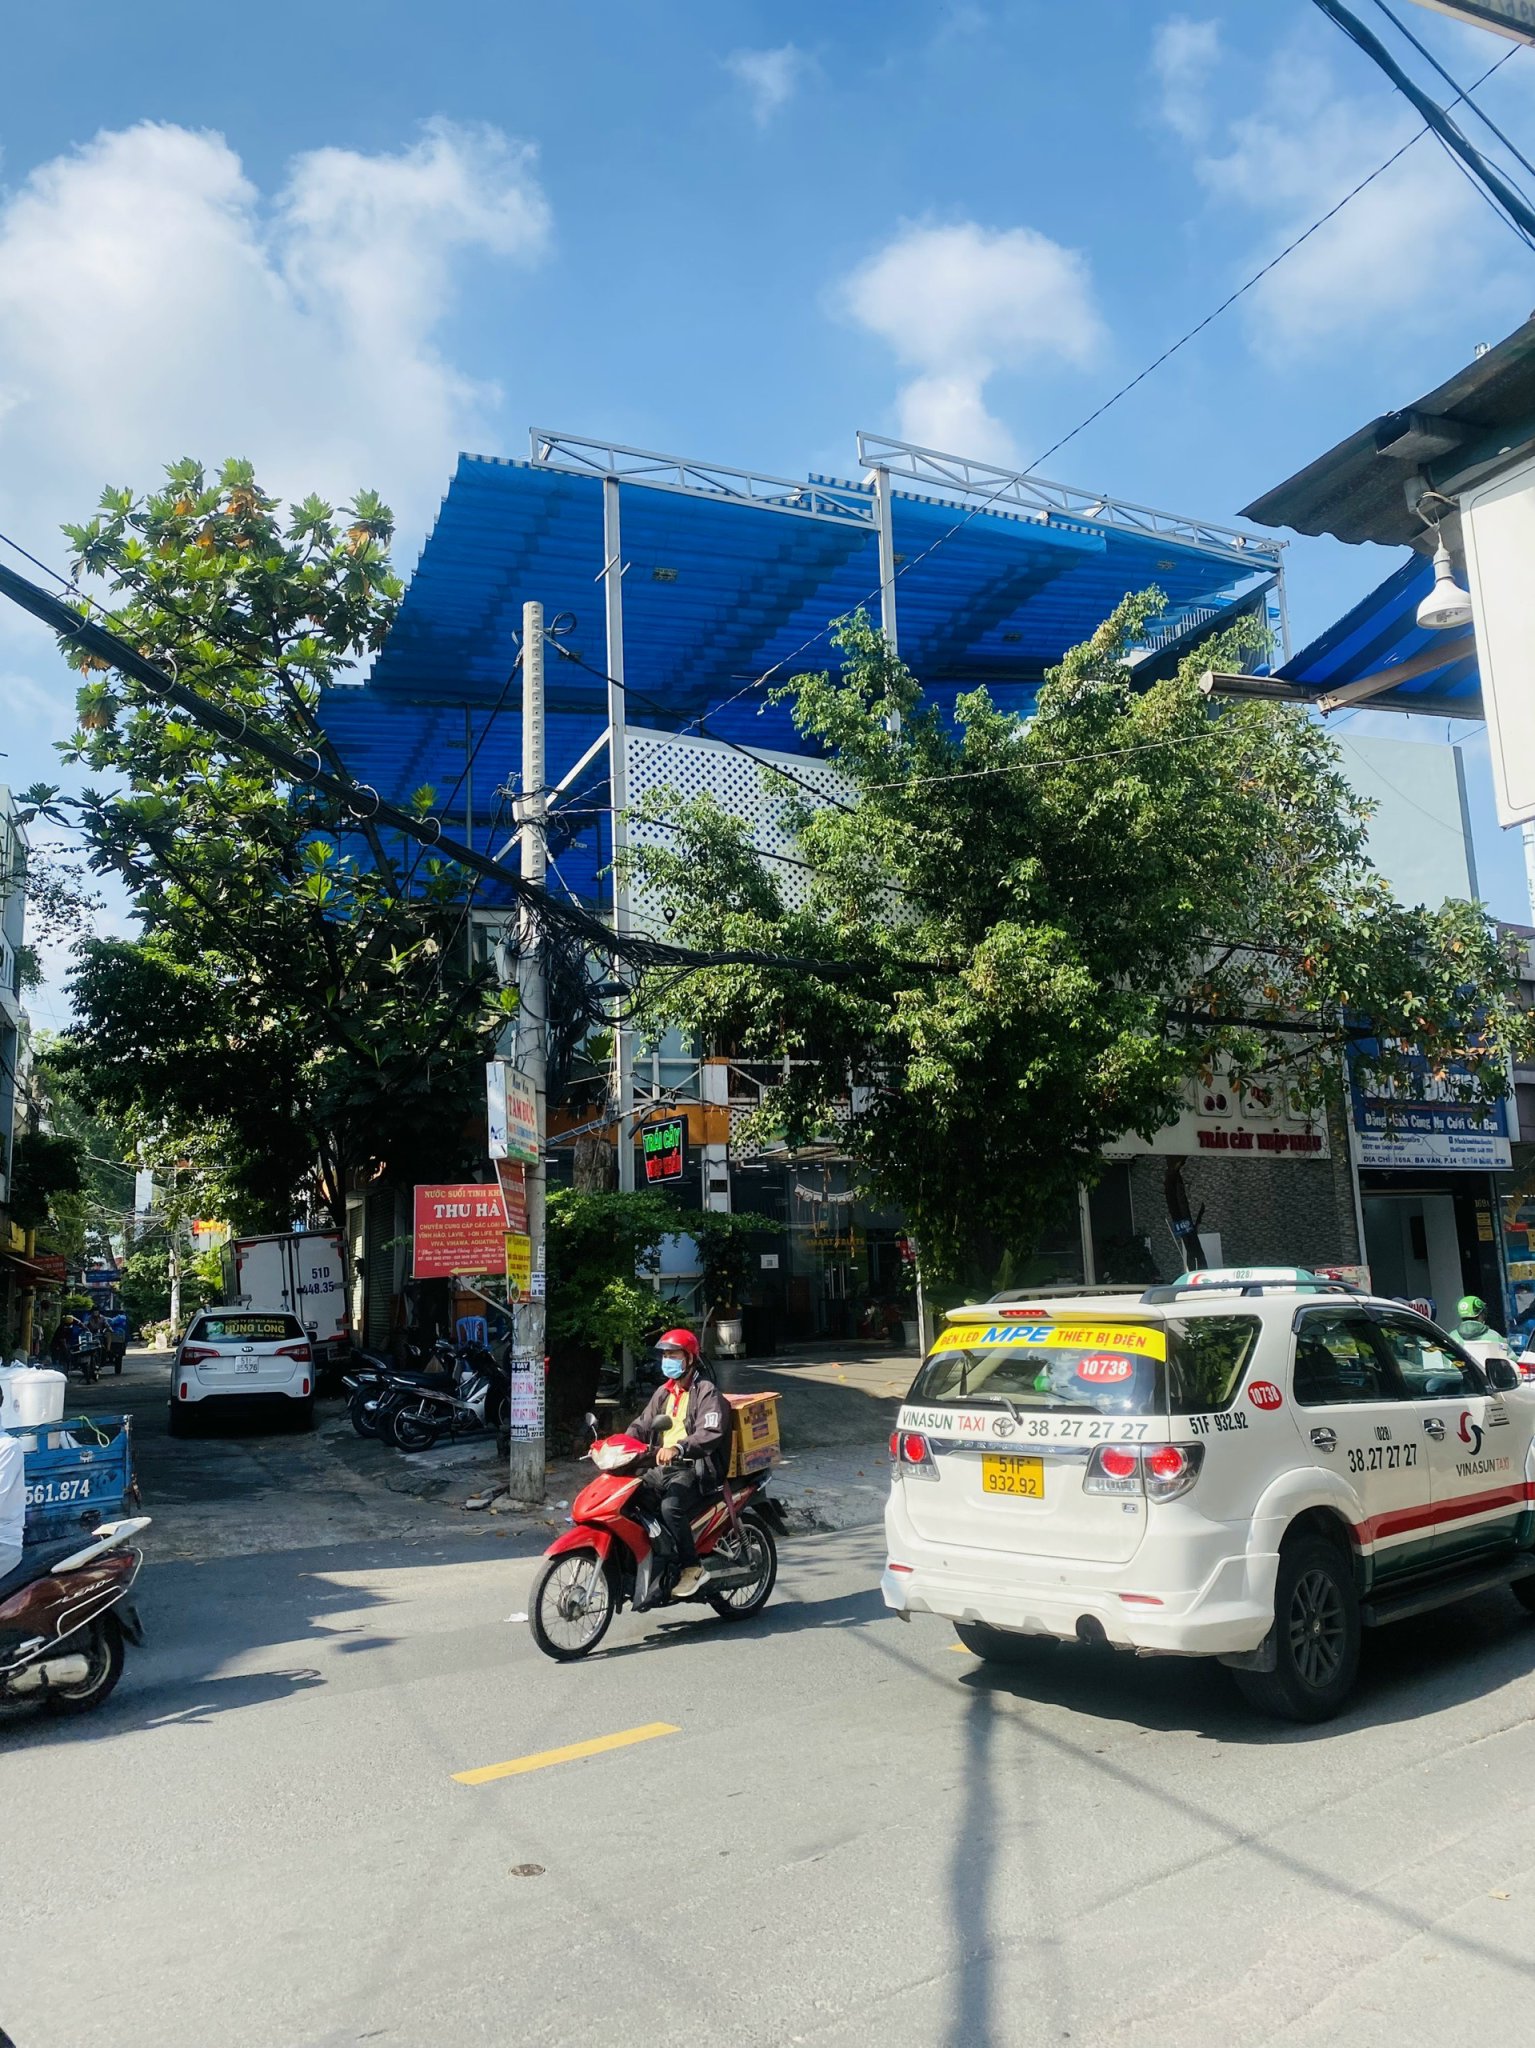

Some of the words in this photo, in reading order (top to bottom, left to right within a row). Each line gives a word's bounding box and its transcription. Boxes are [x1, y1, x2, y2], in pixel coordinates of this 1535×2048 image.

[1411, 1115, 1431, 1130] Cùng
[1433, 1114, 1444, 1132] Nụ
[1483, 1118, 1498, 1134] Bạn
[643, 1127, 663, 1152] TRÁI
[663, 1124, 681, 1148] CÂY
[1197, 1126, 1229, 1148] TRÁI
[1230, 1127, 1254, 1149] CÂY
[448, 1187, 466, 1198] SUỐI
[433, 1204, 471, 1218] THU
[475, 1199, 501, 1217] HÀ
[311, 1266, 330, 1279] 51D
[1233, 1269, 1253, 1279] (028)
[302, 1281, 335, 1295] 448.35
[225, 1322, 255, 1333] HÙNG
[257, 1324, 285, 1333] LONG
[959, 1331, 979, 1343] LED
[981, 1326, 1056, 1342] MPE
[1057, 1328, 1093, 1342] THIẾT
[1095, 1332, 1111, 1346] BỊ
[1112, 1331, 1147, 1348] ĐIỆN
[1083, 1360, 1127, 1375] 10738
[1249, 1385, 1279, 1404] 10738
[902, 1411, 953, 1429] VINASUN
[957, 1415, 985, 1432] TAXI
[1088, 1421, 1114, 1439] 27
[1121, 1423, 1149, 1440] 27
[1189, 1416, 1210, 1434] 51F
[1214, 1412, 1248, 1431] 932.92
[1374, 1426, 1392, 1440] (028)
[1000, 1457, 1025, 1474] 51F
[1348, 1447, 1382, 1473] 38.27
[1386, 1445, 1400, 1468] 27
[1403, 1443, 1417, 1466] 27
[25, 1479, 90, 1505] 561.874
[989, 1475, 1036, 1495] 932.92
